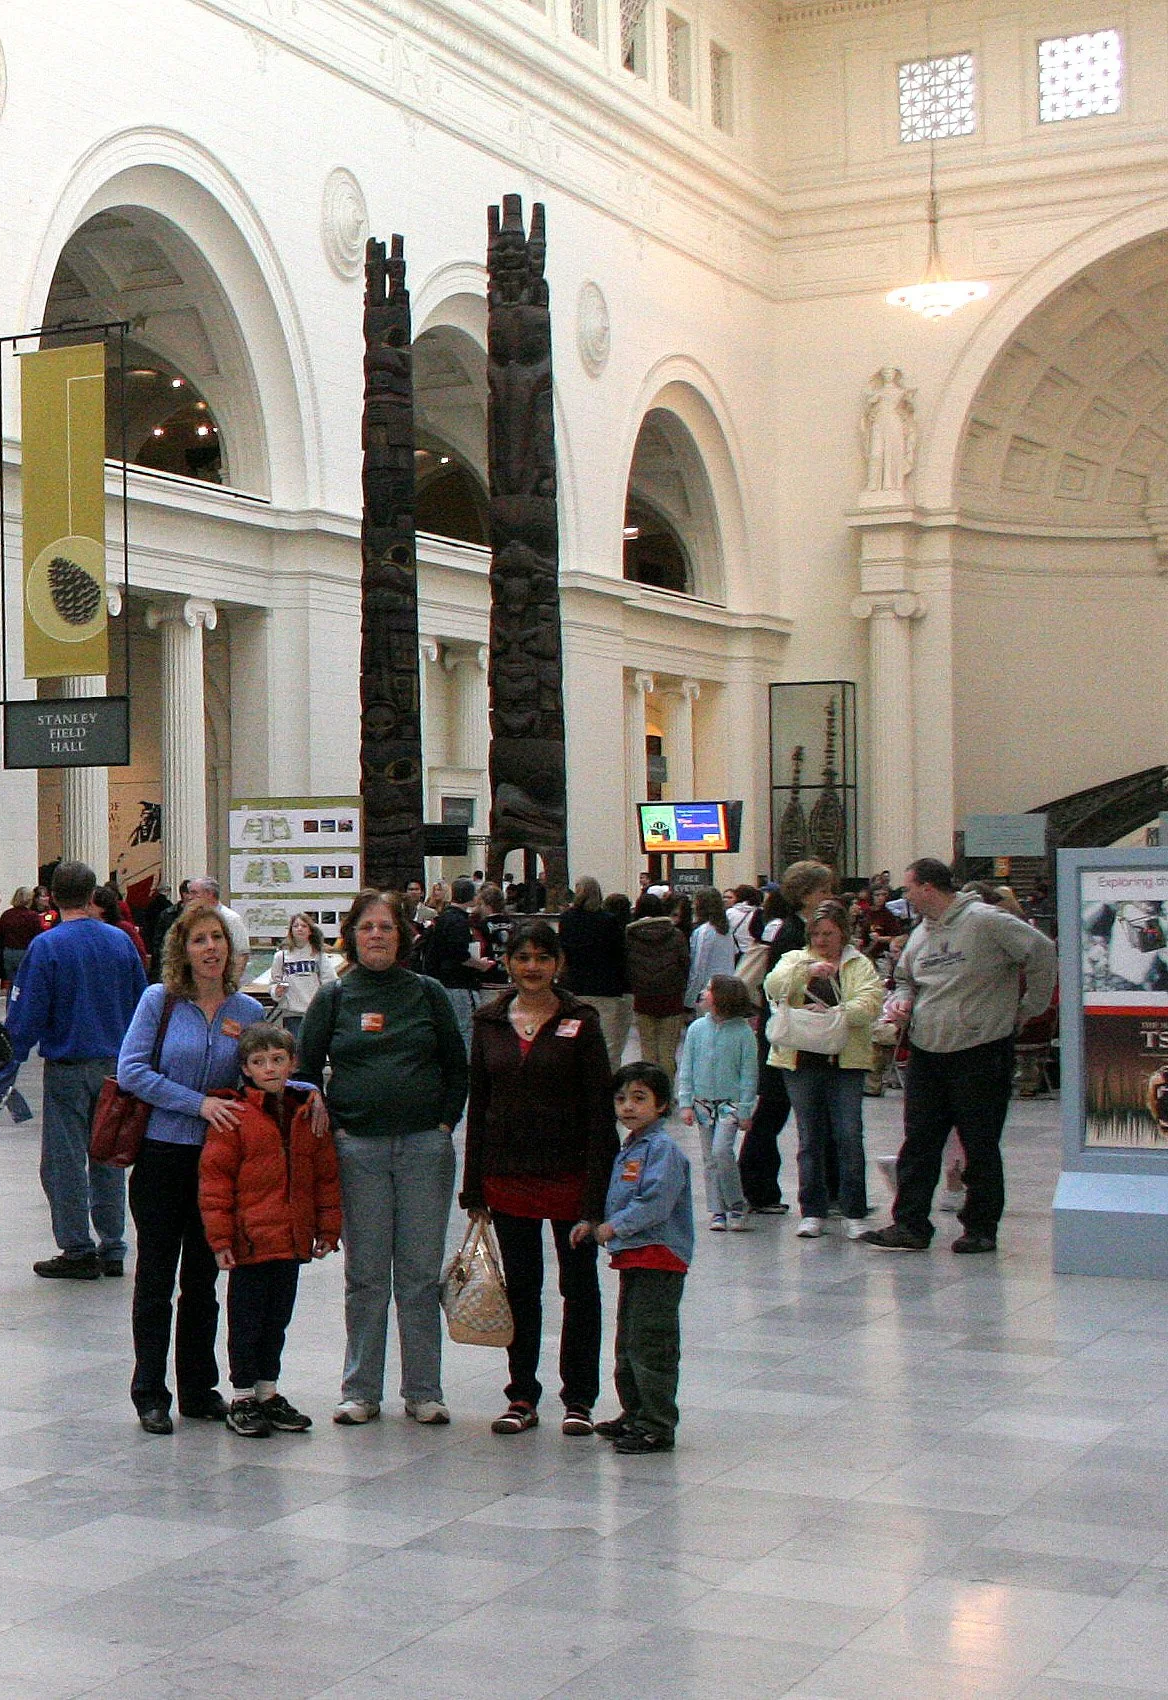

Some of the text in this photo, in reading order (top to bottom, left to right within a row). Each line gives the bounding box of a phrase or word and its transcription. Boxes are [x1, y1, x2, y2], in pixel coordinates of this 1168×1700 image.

[36, 712, 98, 726] STANLEY
[49, 727, 86, 739] FIELD
[50, 741, 85, 753] HALL
[1098, 876, 1168, 889] Exploring th
